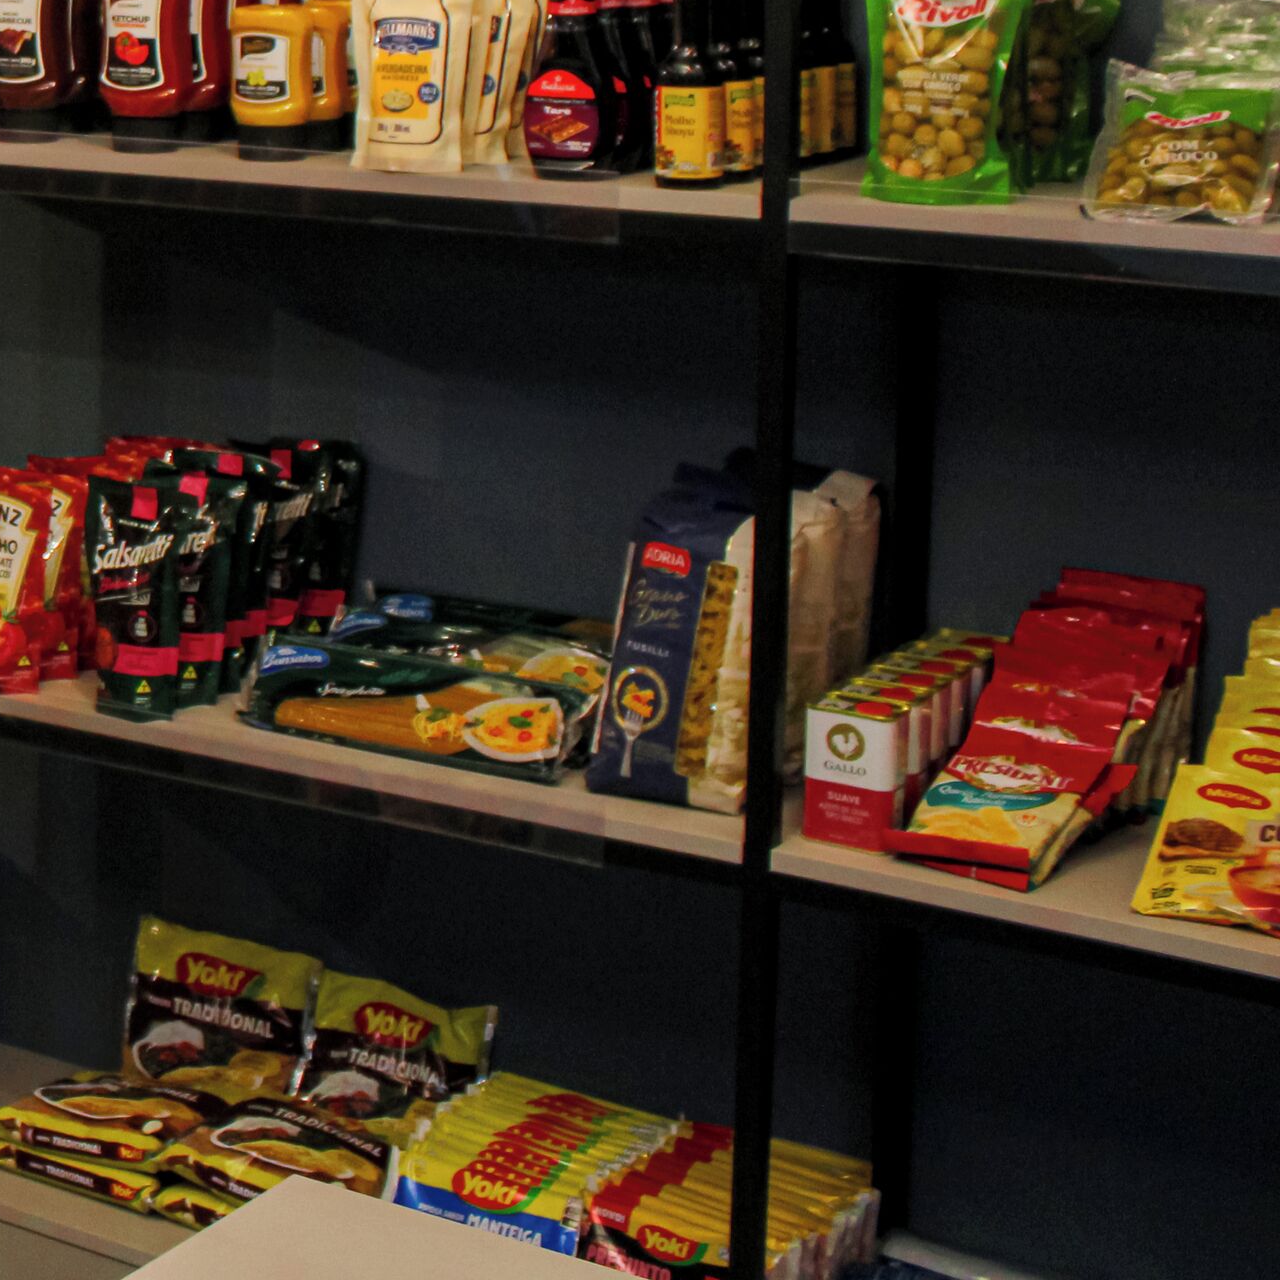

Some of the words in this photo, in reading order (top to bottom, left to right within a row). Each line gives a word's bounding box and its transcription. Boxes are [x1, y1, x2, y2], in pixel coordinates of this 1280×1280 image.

[645, 547, 686, 568] ADRIA
[823, 759, 867, 777] GALLO
[827, 790, 861, 806] SUAVE
[184, 957, 249, 992] Yoki
[172, 997, 275, 1040] TRADICIONAL
[361, 1008, 424, 1042] Yoki
[52, 1135, 102, 1156] TRADICIONAL
[273, 1105, 385, 1158] TRADICIONAL
[462, 1171, 517, 1206] Yoki
